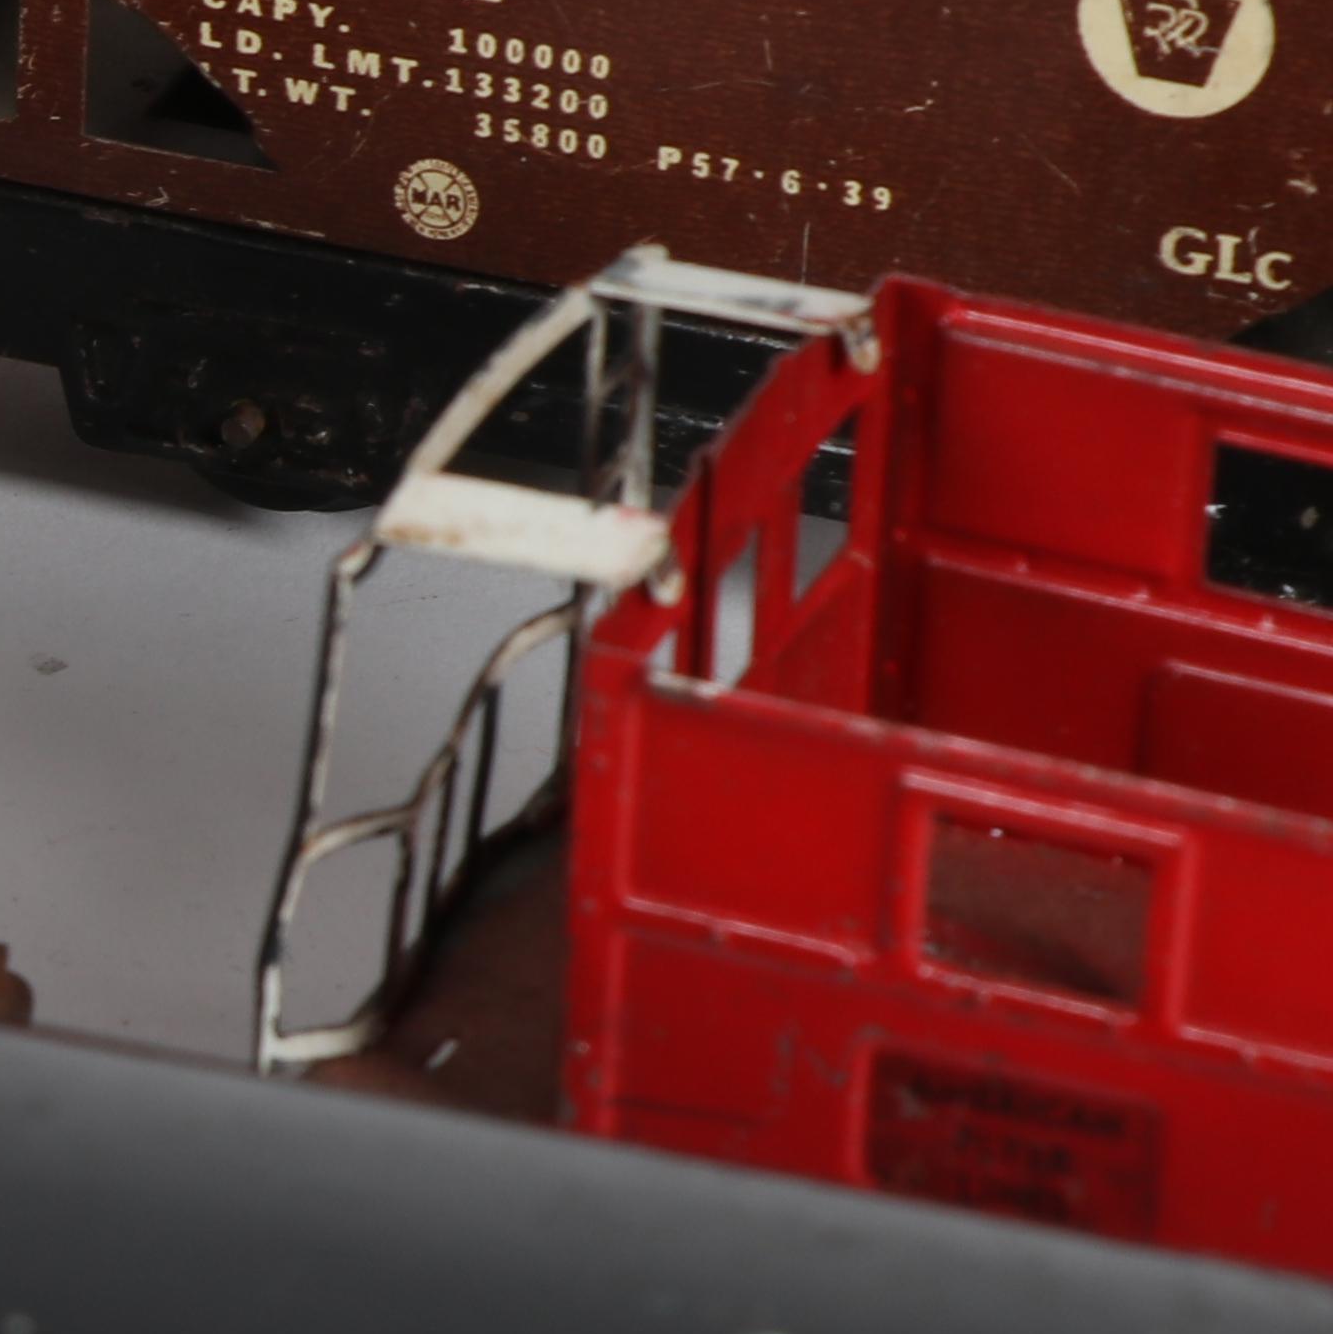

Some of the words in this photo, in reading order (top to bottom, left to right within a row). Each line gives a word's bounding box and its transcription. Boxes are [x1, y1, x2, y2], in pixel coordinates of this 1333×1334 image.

[200, 22, 282, 61] LD.
[312, 44, 434, 88] LMT.
[445, 68, 608, 119] 133200
[448, 28, 611, 79] 100000
[285, 77, 372, 116] WT.
[474, 112, 607, 159] 35800
